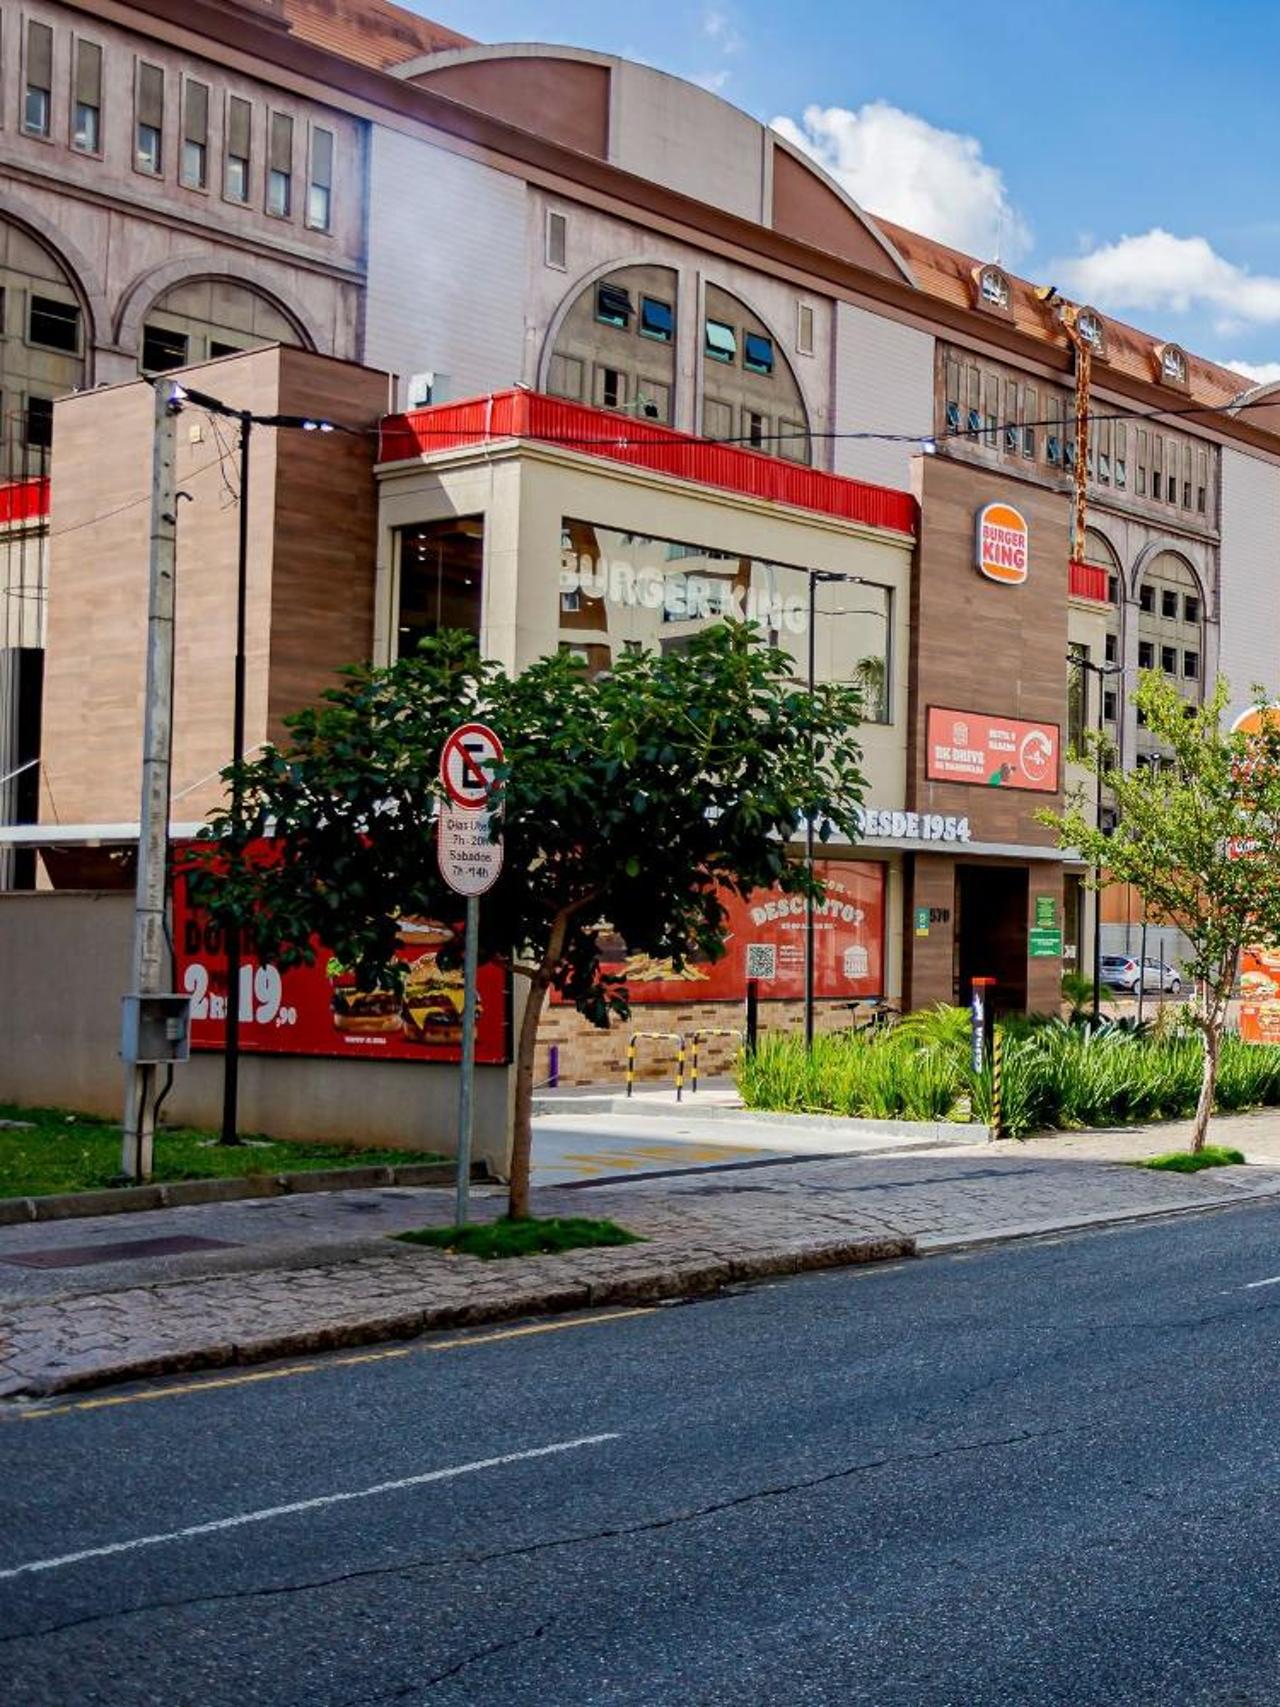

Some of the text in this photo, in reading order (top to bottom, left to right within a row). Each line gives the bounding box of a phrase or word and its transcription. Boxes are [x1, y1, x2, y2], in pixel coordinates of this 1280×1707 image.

[983, 526, 1025, 548] BURGER
[983, 542, 1025, 569] KING
[560, 554, 808, 634] BURGER KING
[453, 834, 465, 845] 7h
[858, 810, 918, 837] DESDE
[922, 814, 972, 842] 1954
[184, 963, 208, 1020] 2
